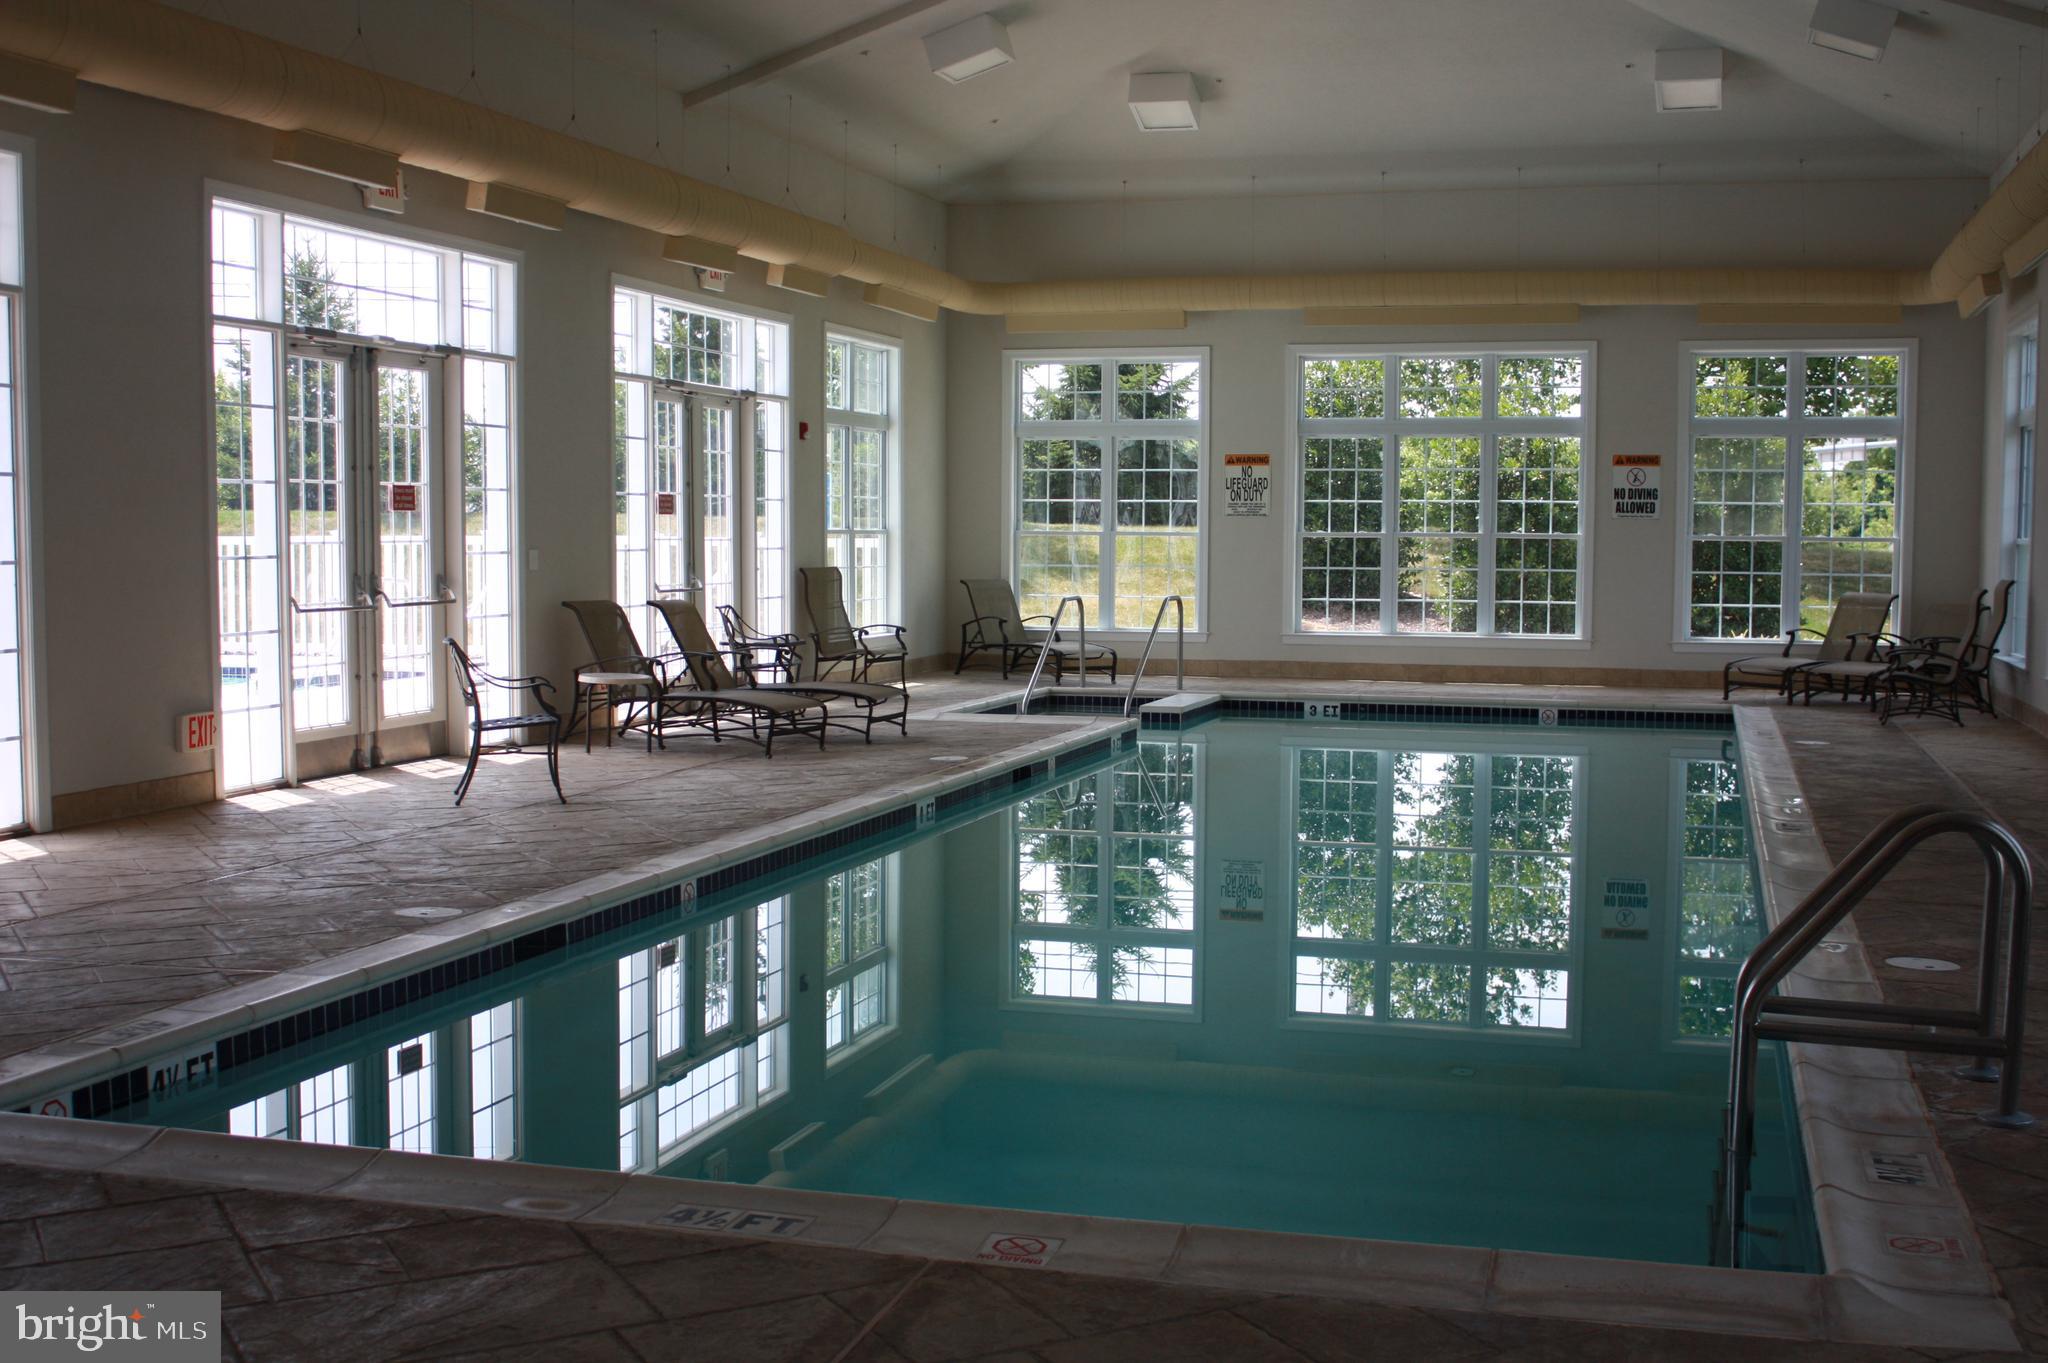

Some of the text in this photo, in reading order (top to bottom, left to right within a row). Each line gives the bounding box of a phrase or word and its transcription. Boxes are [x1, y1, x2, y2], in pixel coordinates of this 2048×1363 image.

[1235, 456, 1269, 464] WARNING
[1241, 465, 1252, 478] NO
[1225, 477, 1269, 490] LIFEGUARD
[1230, 489, 1264, 502] ON DUTY
[1613, 488, 1658, 500] NO DIVING
[1615, 501, 1656, 514] ALLOWED
[188, 714, 214, 748] EXIT
[732, 1213, 805, 1234] FT
